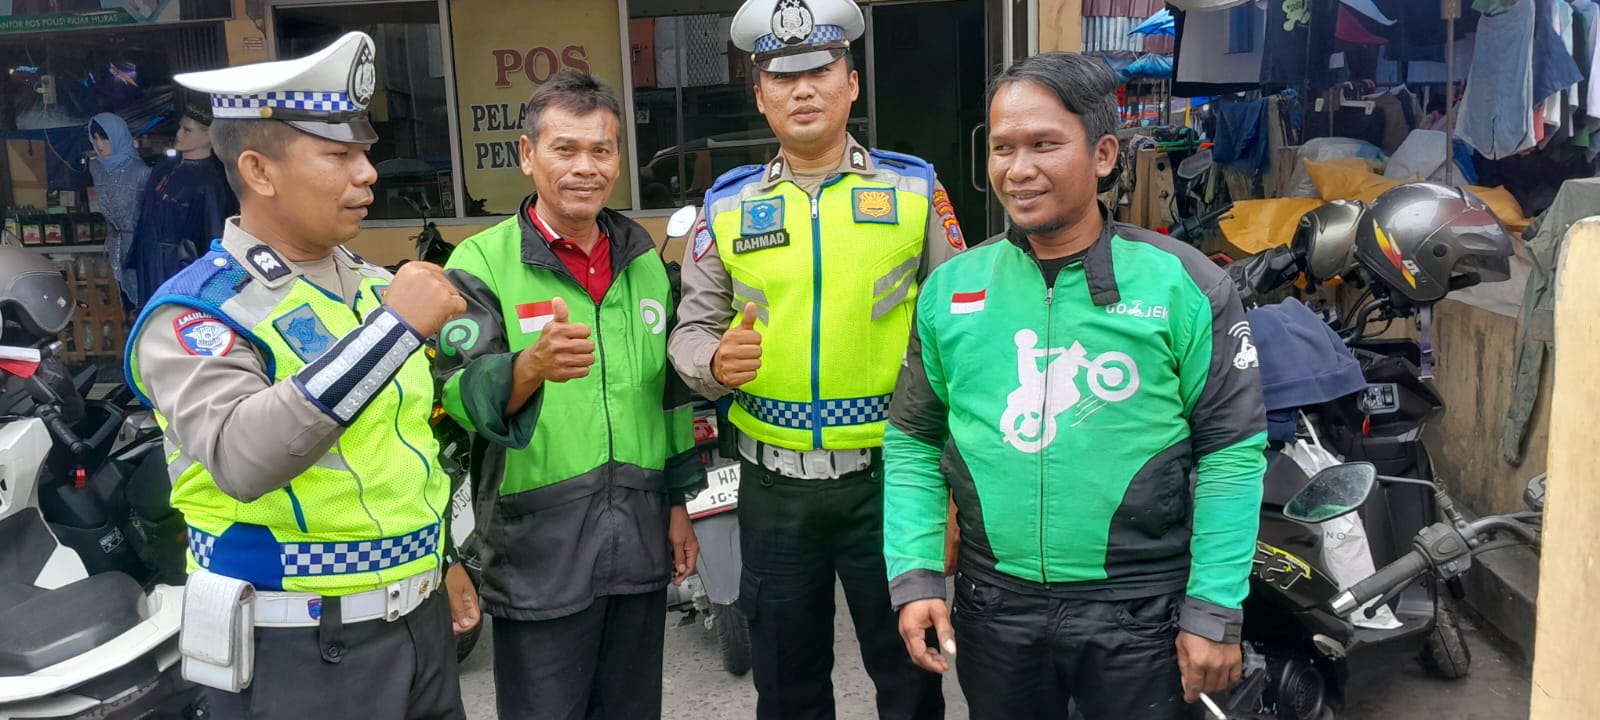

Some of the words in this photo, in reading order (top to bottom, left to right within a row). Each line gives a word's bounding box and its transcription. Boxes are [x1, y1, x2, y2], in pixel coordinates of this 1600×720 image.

[492, 45, 590, 87] POS
[475, 141, 520, 169] PEN
[735, 232, 785, 252] RAHMAD
[717, 468, 738, 485] WA
